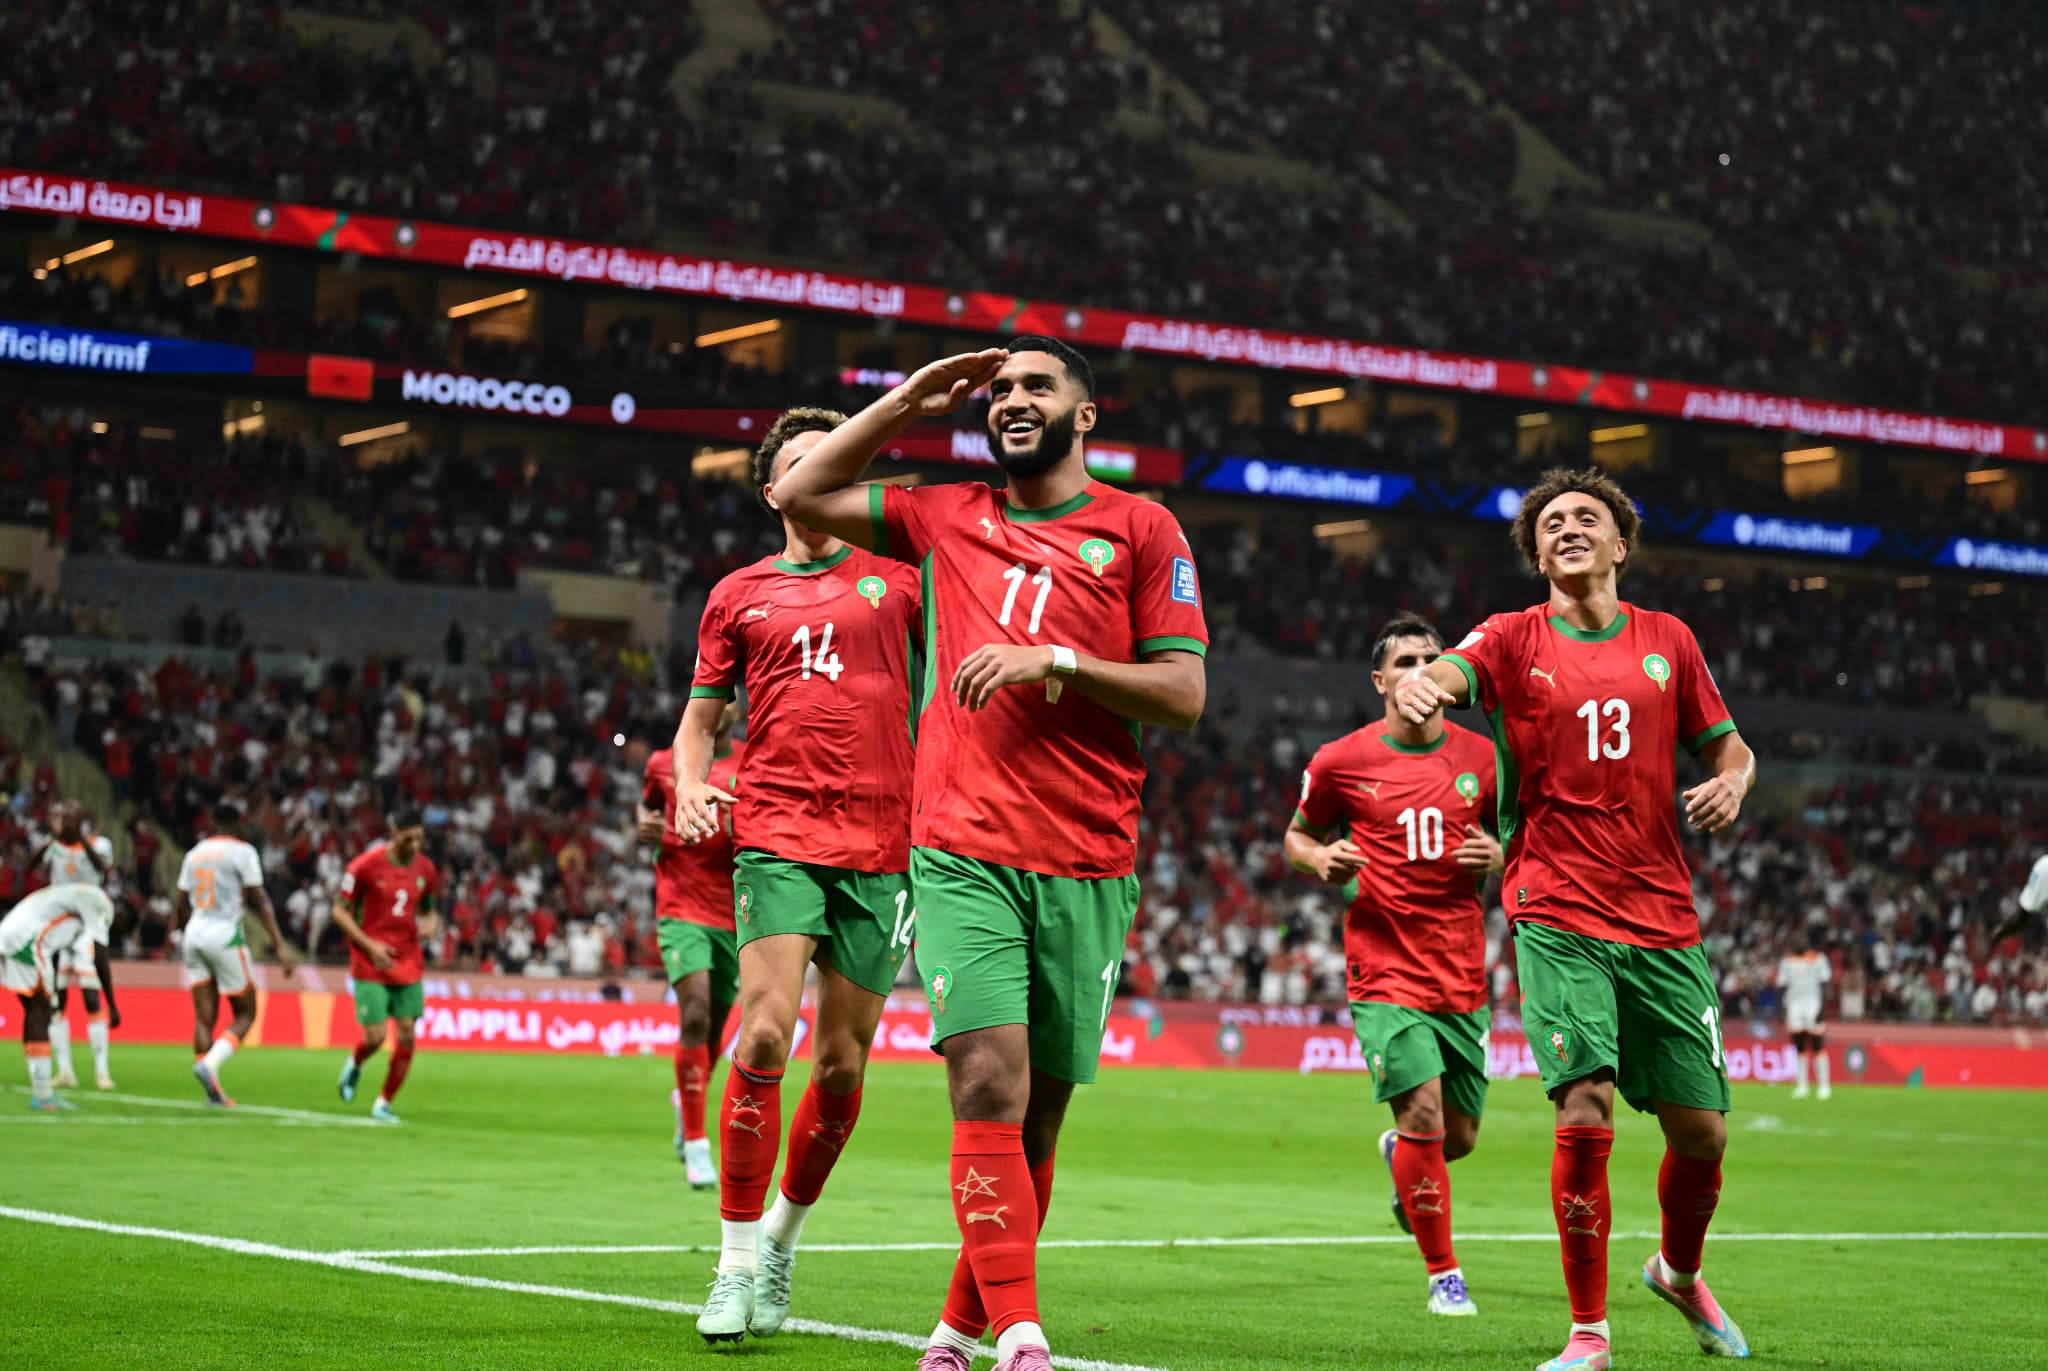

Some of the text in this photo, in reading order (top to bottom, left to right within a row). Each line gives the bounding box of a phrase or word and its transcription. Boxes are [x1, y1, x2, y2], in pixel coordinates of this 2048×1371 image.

[0, 175, 202, 231] الجامعة الملكي
[0, 326, 150, 372] ficielfrmf
[402, 369, 636, 424] MOROCCO 0
[998, 562, 1053, 634] 11
[792, 622, 844, 681] 14
[1576, 698, 1631, 762] 13
[1396, 806, 1444, 861] 10
[392, 888, 409, 917] 2
[1702, 1005, 1728, 1068] 1
